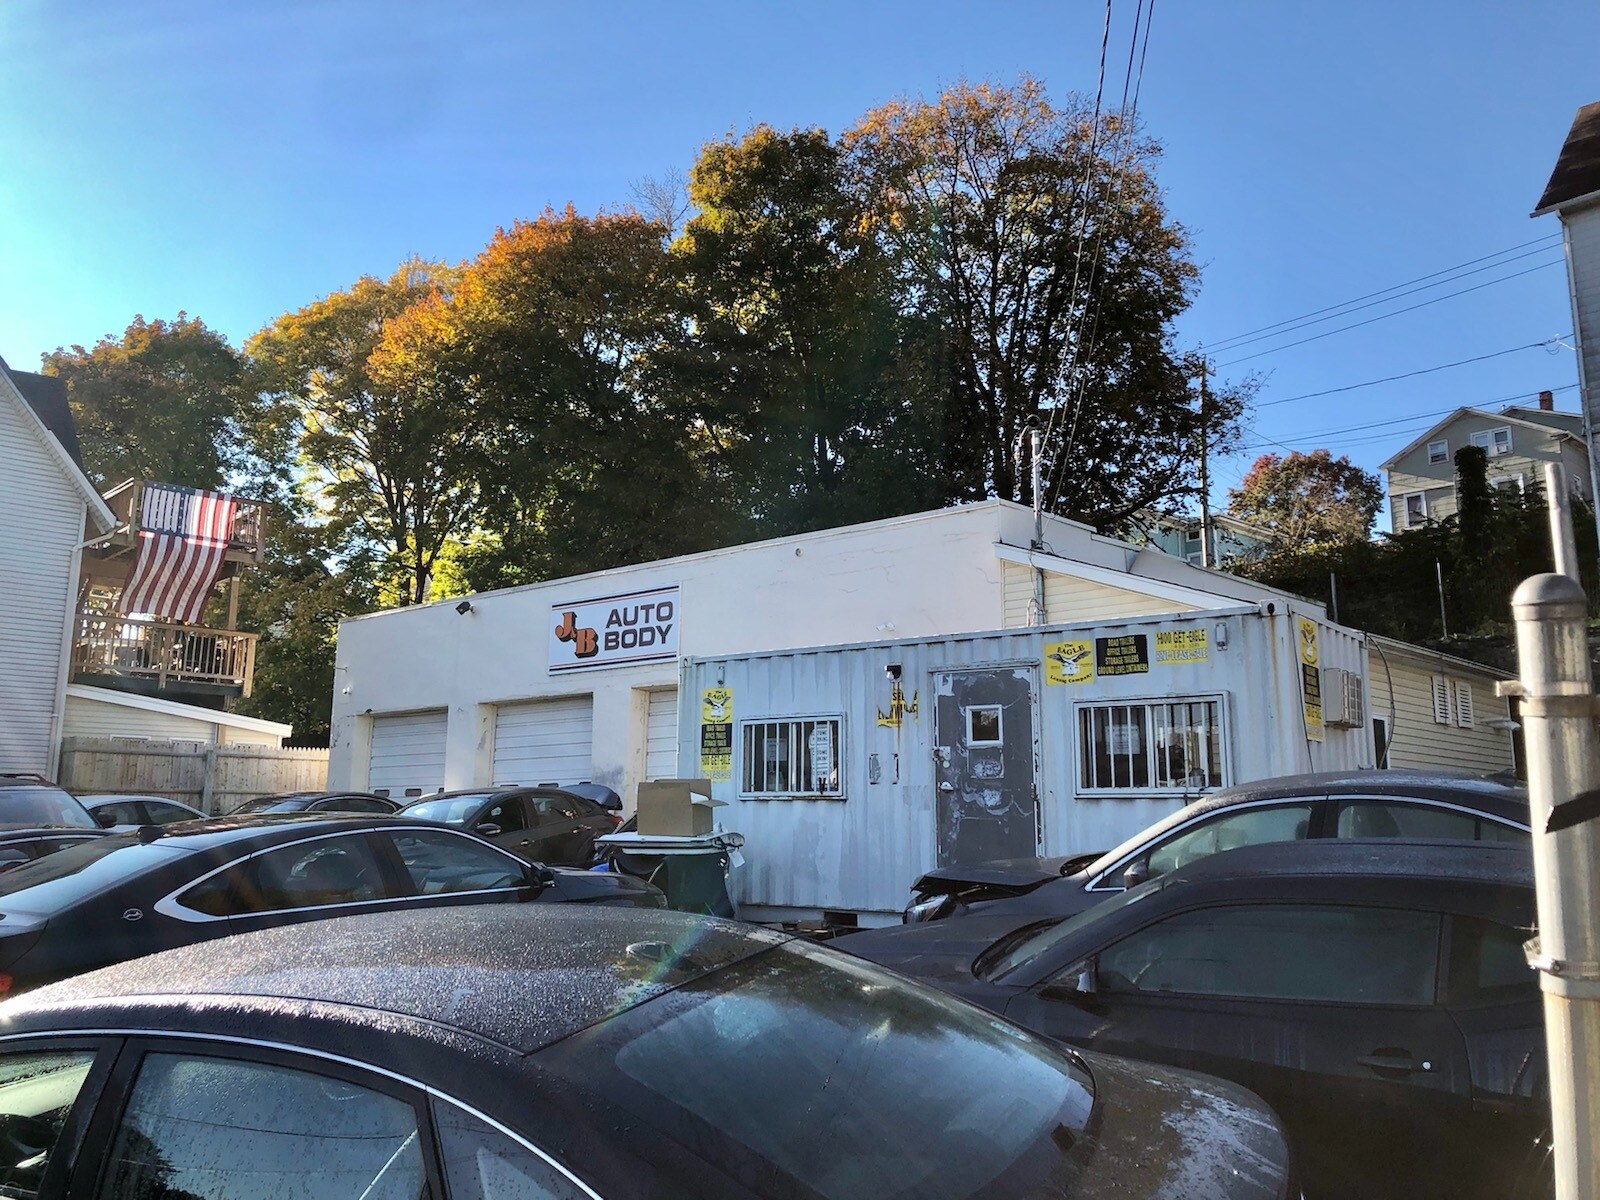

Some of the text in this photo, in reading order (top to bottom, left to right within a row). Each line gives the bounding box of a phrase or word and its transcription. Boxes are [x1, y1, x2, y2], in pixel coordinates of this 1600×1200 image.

[605, 601, 674, 629] AUTO
[604, 624, 673, 651] BODY
[1057, 644, 1085, 655] EAGLE
